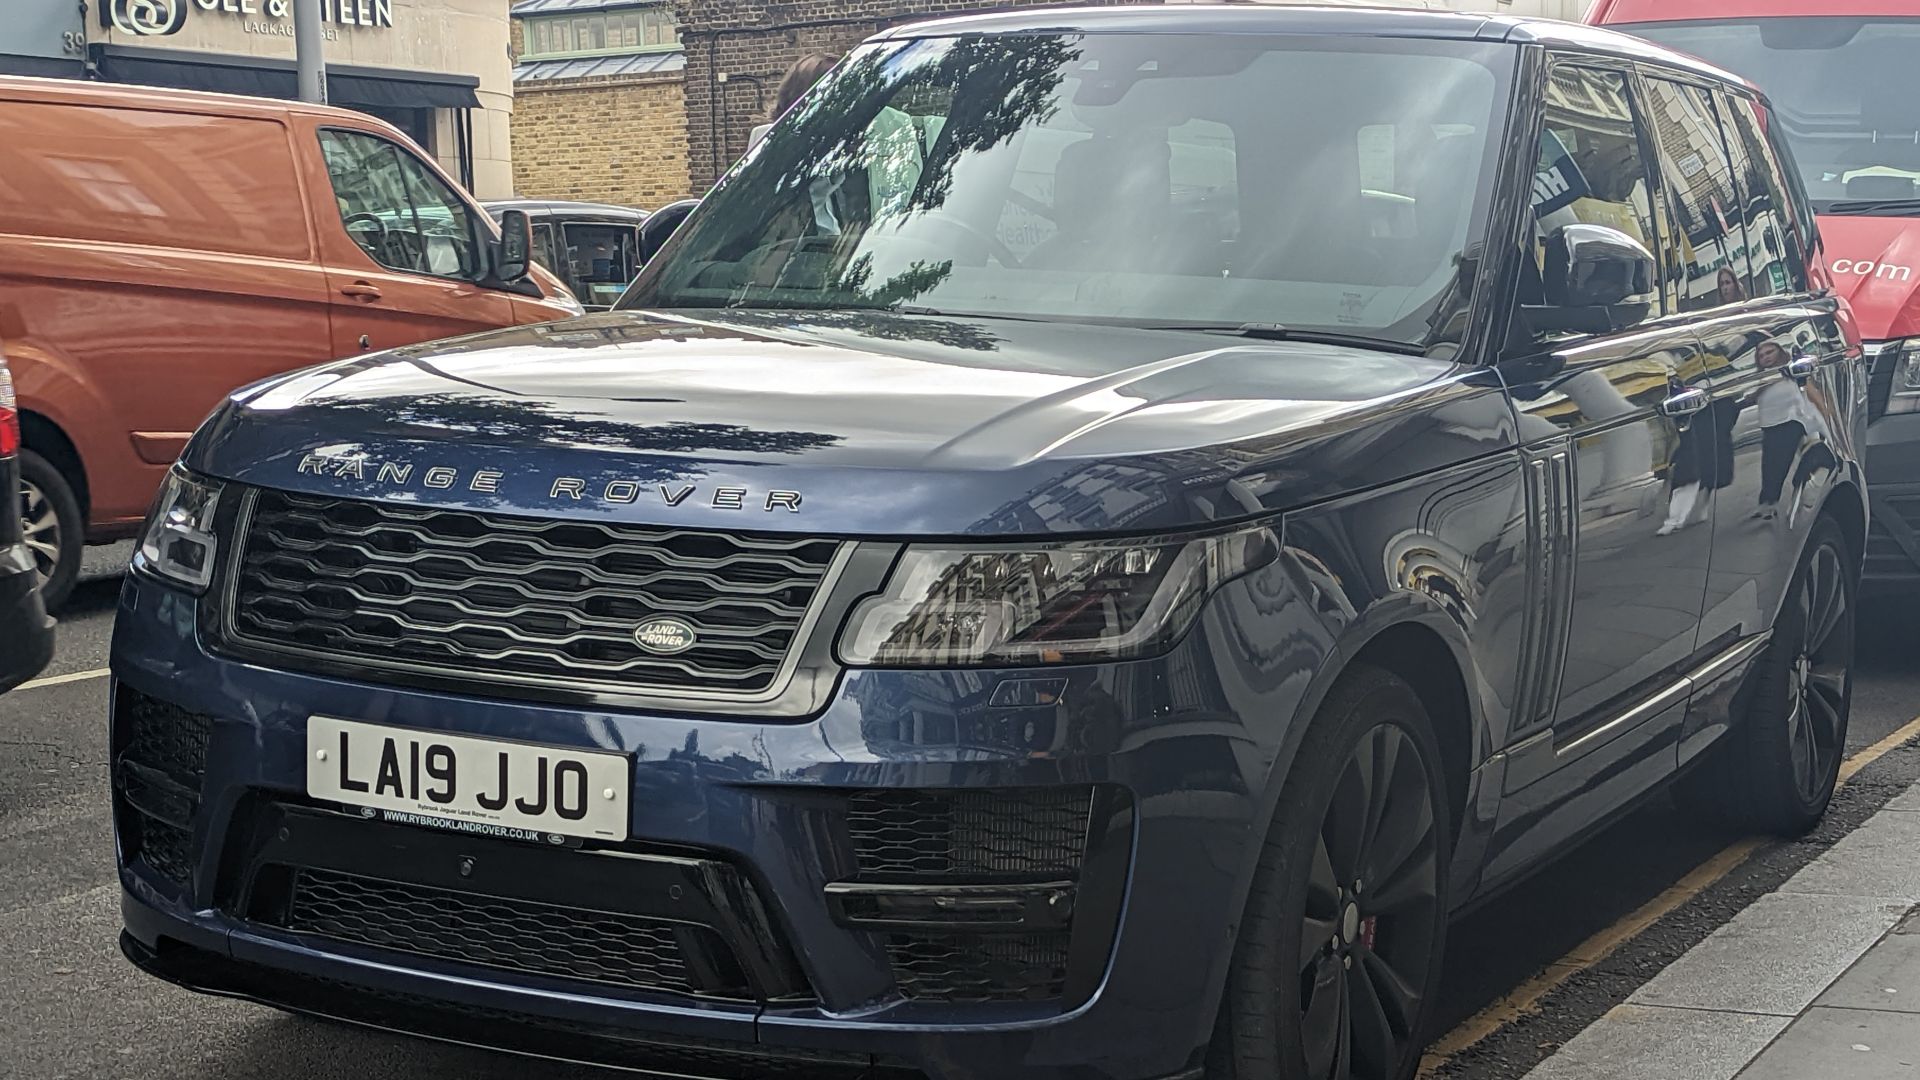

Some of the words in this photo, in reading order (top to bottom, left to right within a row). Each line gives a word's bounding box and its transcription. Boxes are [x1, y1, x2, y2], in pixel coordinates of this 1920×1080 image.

[325, 0, 392, 28] TEEN
[64, 31, 85, 52] 39
[1831, 259, 1911, 281] com
[297, 453, 505, 494] RANGE
[550, 477, 803, 513] ROVER
[646, 634, 684, 646] ROVER
[339, 731, 457, 804] LA19
[476, 751, 588, 820] JJO
[383, 810, 539, 841] WWW.RYBROOKLANDROVER.CO.UK
